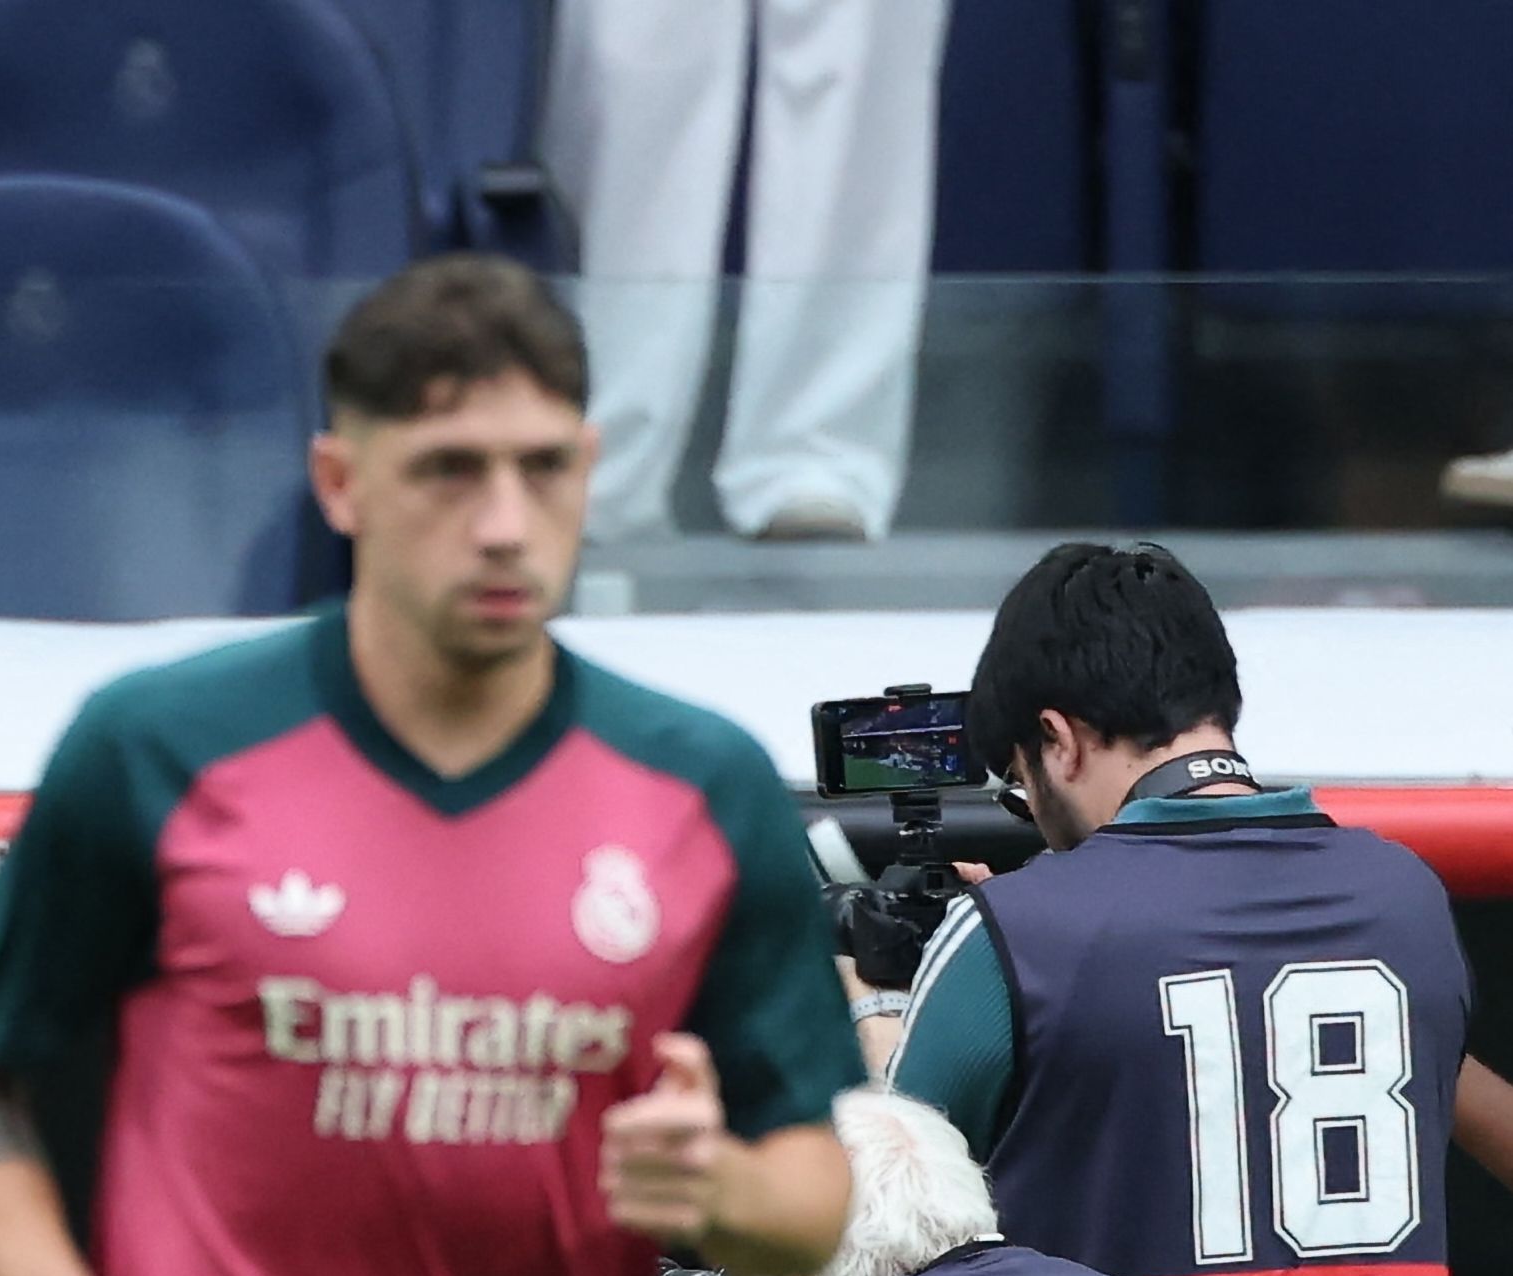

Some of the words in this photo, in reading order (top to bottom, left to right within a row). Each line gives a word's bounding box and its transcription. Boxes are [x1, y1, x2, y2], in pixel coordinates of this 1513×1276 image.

[1188, 758, 1251, 779] SON
[256, 972, 634, 1075] Emirates
[1159, 959, 1421, 1266] 18
